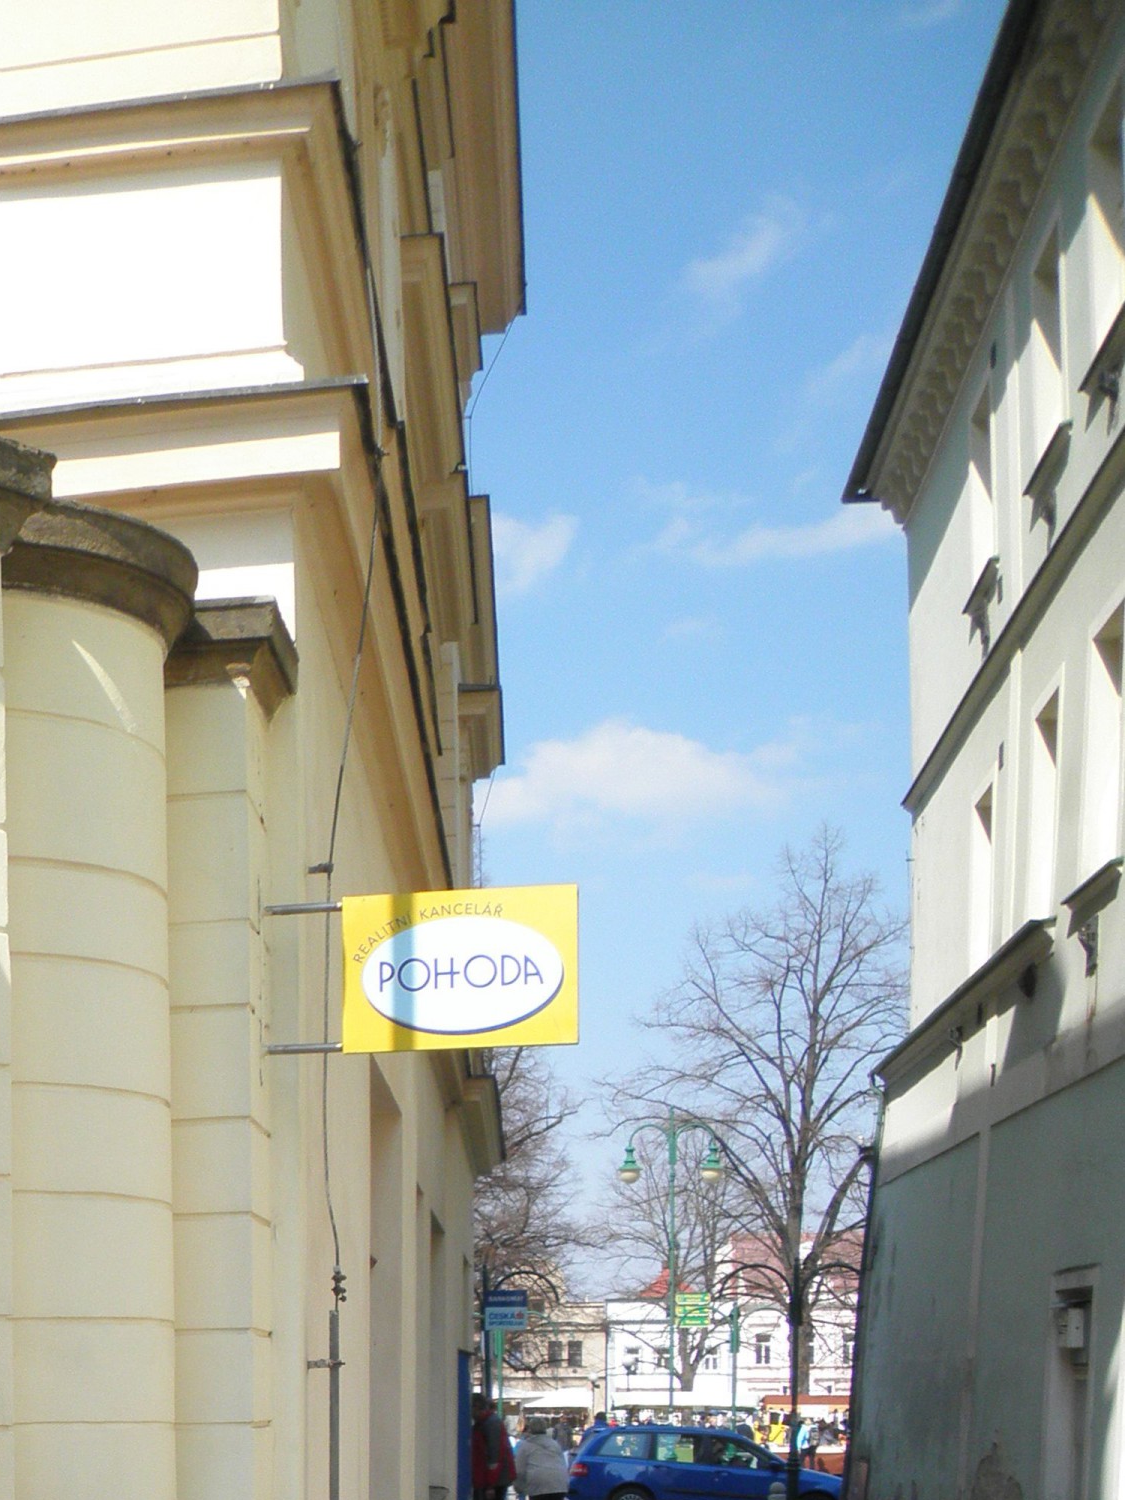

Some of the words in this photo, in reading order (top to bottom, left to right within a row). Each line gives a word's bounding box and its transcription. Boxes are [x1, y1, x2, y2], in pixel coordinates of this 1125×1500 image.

[353, 910, 412, 963] REALITNÍ
[419, 902, 504, 920] KANCELÁŘ
[379, 954, 544, 992] POHODA
